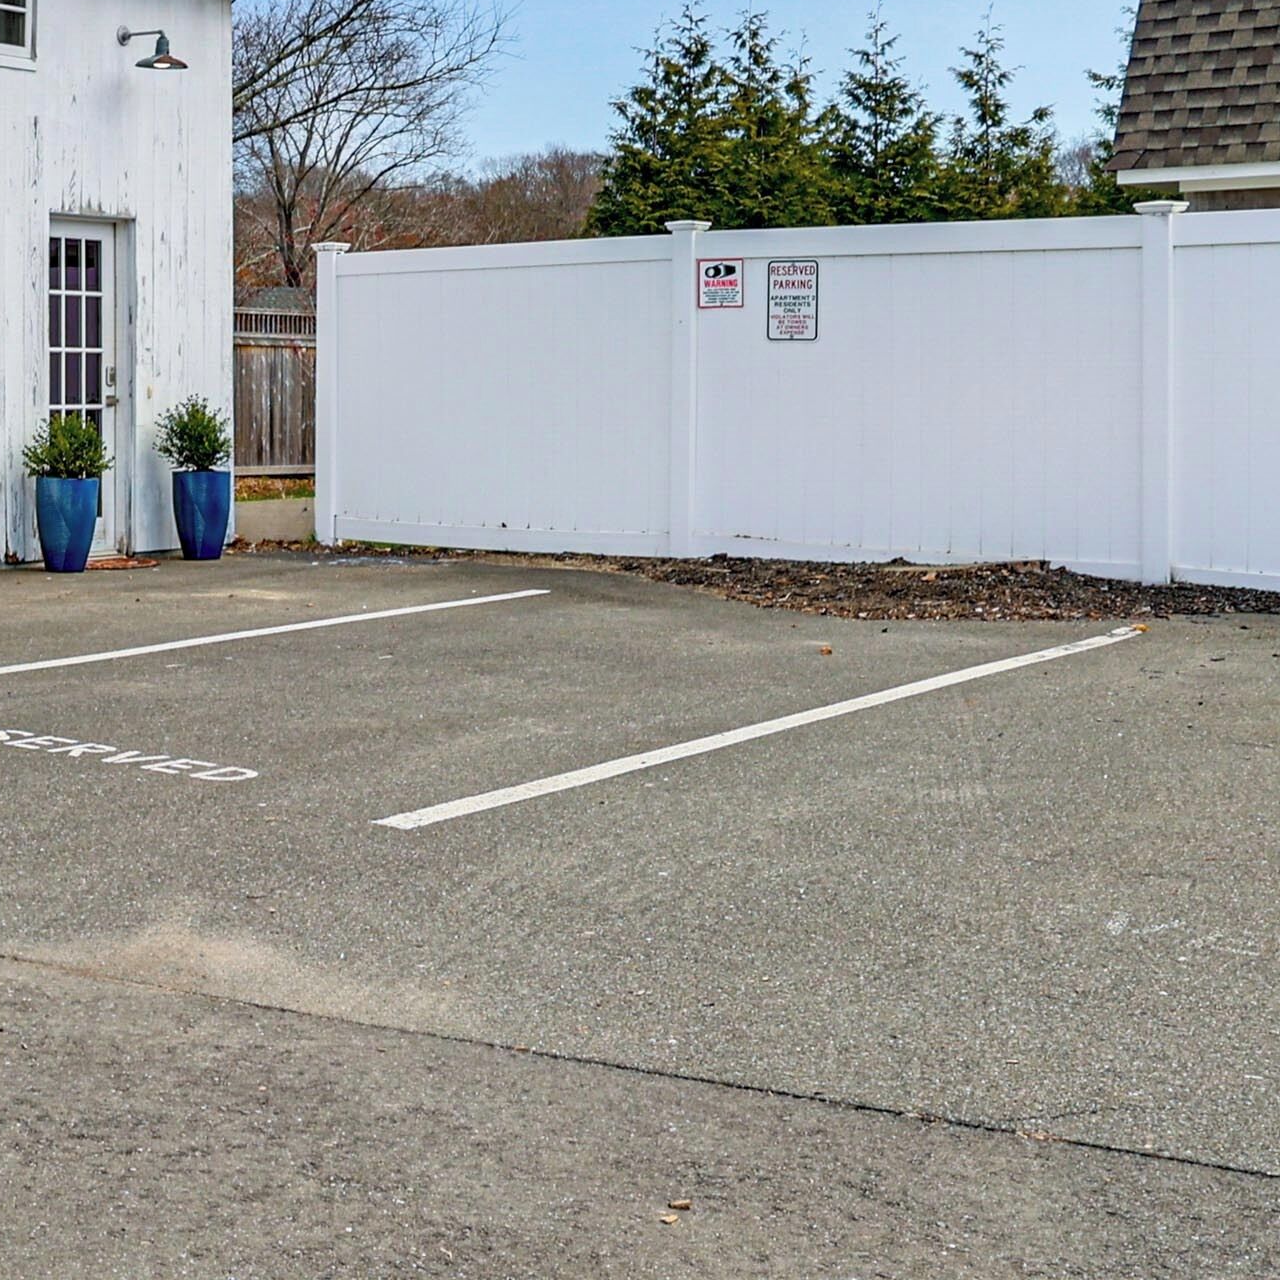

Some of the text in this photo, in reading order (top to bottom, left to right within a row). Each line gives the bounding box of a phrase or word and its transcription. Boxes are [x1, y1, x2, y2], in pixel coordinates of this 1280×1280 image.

[770, 265, 816, 276] RESERVED
[704, 280, 738, 288] WARNING
[773, 279, 813, 290] PARKING
